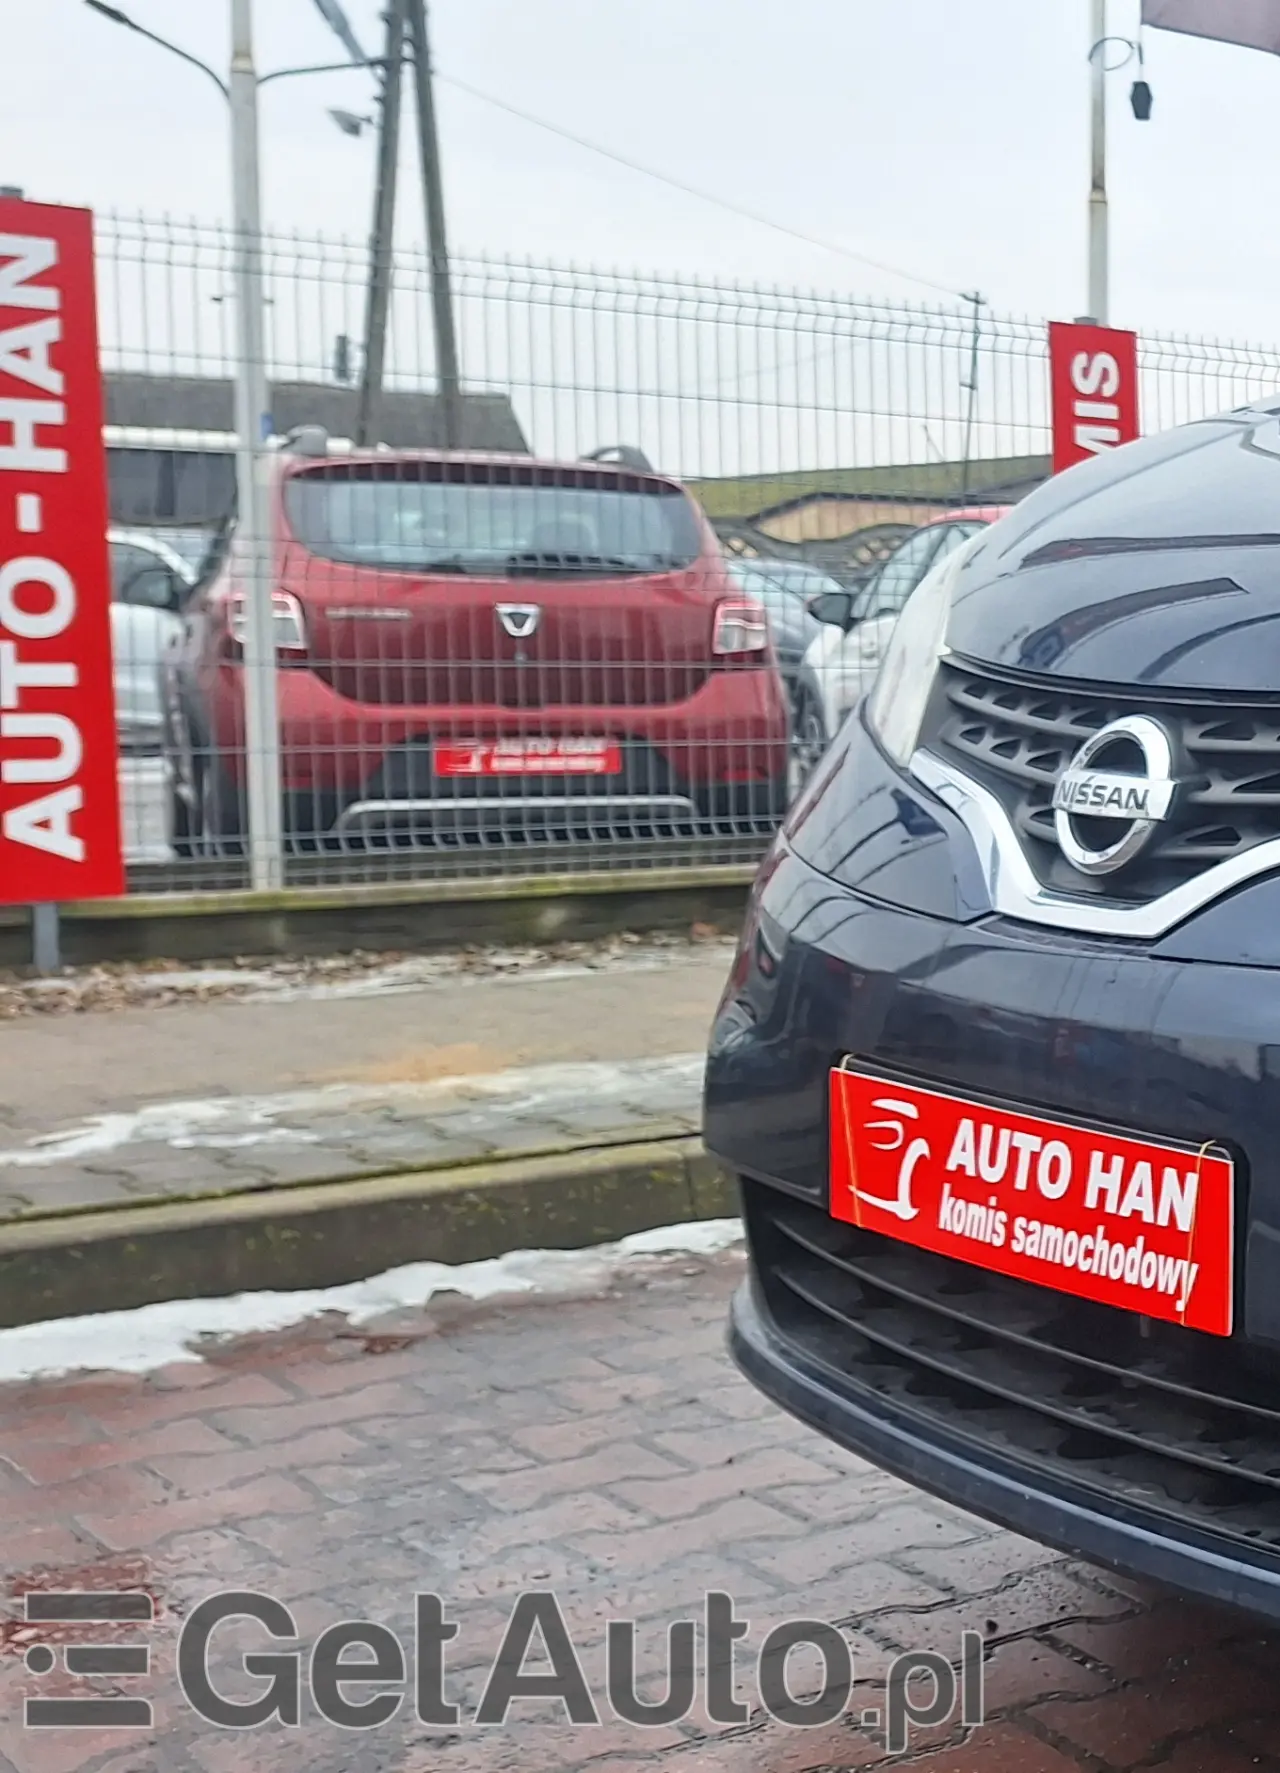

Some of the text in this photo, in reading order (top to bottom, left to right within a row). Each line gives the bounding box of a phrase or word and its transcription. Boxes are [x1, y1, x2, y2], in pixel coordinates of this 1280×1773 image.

[0, 232, 69, 473] HAN
[0, 555, 85, 863] AUTO
[1057, 779, 1150, 811] NISSAN
[945, 1117, 1200, 1233] AUTO HAN
[938, 1182, 1200, 1313] komis samochodowy
